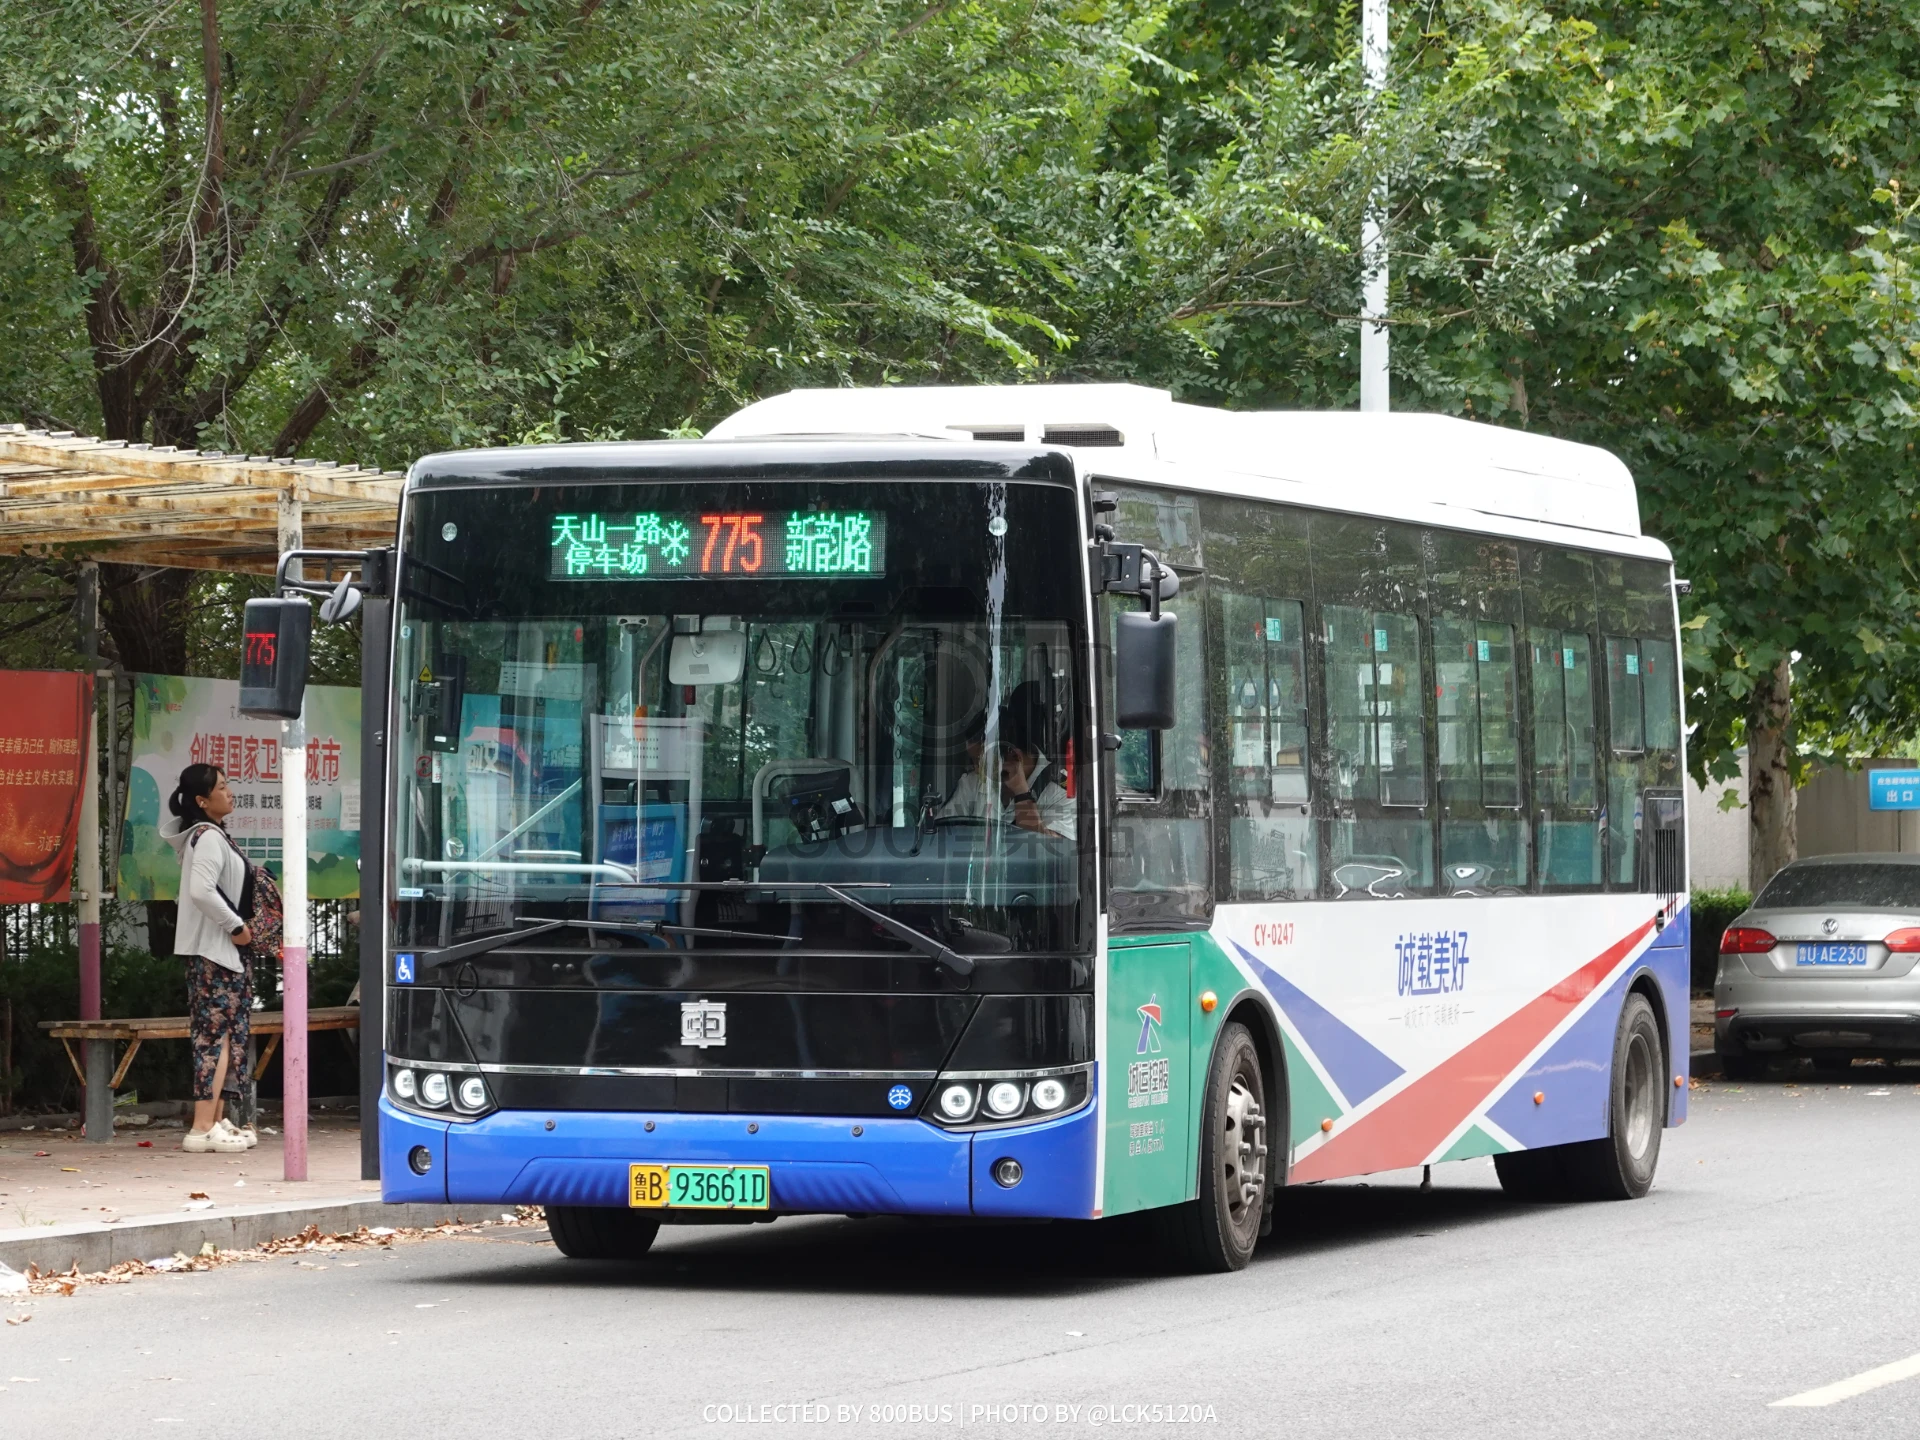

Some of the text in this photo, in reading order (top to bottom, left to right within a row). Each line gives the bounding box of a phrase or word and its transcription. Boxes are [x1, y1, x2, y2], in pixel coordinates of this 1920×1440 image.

[551, 513, 663, 546] 天山一路
[702, 515, 763, 572] 775
[786, 511, 871, 573] 新韵路
[565, 543, 648, 575] 停车场
[245, 632, 276, 666] 775
[190, 732, 341, 782] 创建国家卫城市
[1887, 790, 1913, 802] 出口
[1254, 922, 1294, 947] CY-0247
[1394, 930, 1469, 997] 诚载美好
[1128, 1058, 1169, 1095] 城运控股
